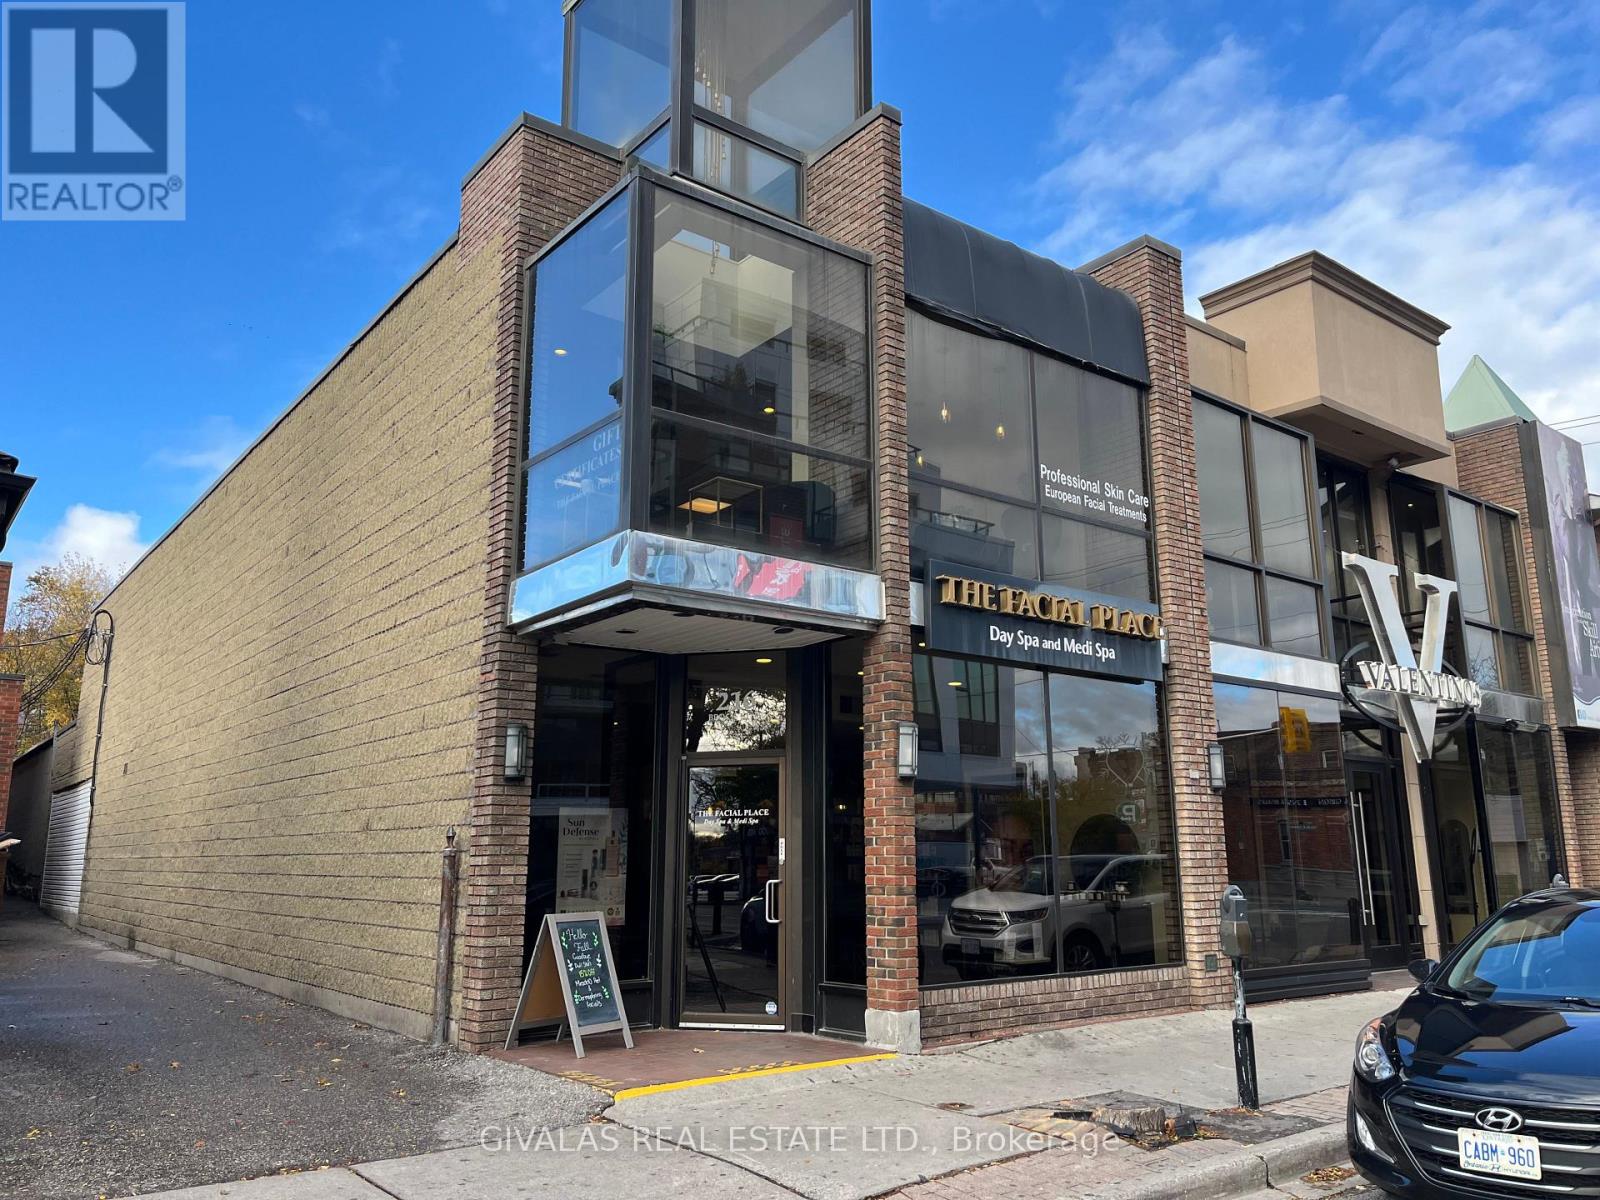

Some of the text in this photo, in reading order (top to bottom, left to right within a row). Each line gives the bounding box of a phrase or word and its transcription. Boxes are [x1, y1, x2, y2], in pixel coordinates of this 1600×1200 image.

[1040, 464, 1149, 508] Professional Skin Care
[1044, 484, 1147, 523] European Facial Treatments
[936, 574, 998, 611] THE
[998, 586, 1089, 628] FACIAL
[989, 625, 1116, 663] Day Spa and Medi Spa
[716, 689, 756, 712] 216
[567, 818, 585, 827] Sun
[715, 808, 743, 817] FACIAL
[743, 808, 770, 817] PLACE
[748, 817, 760, 826] Spa
[562, 827, 599, 837] Defense
[566, 927, 588, 941] Hello
[1464, 1140, 1535, 1168] CABM 960
